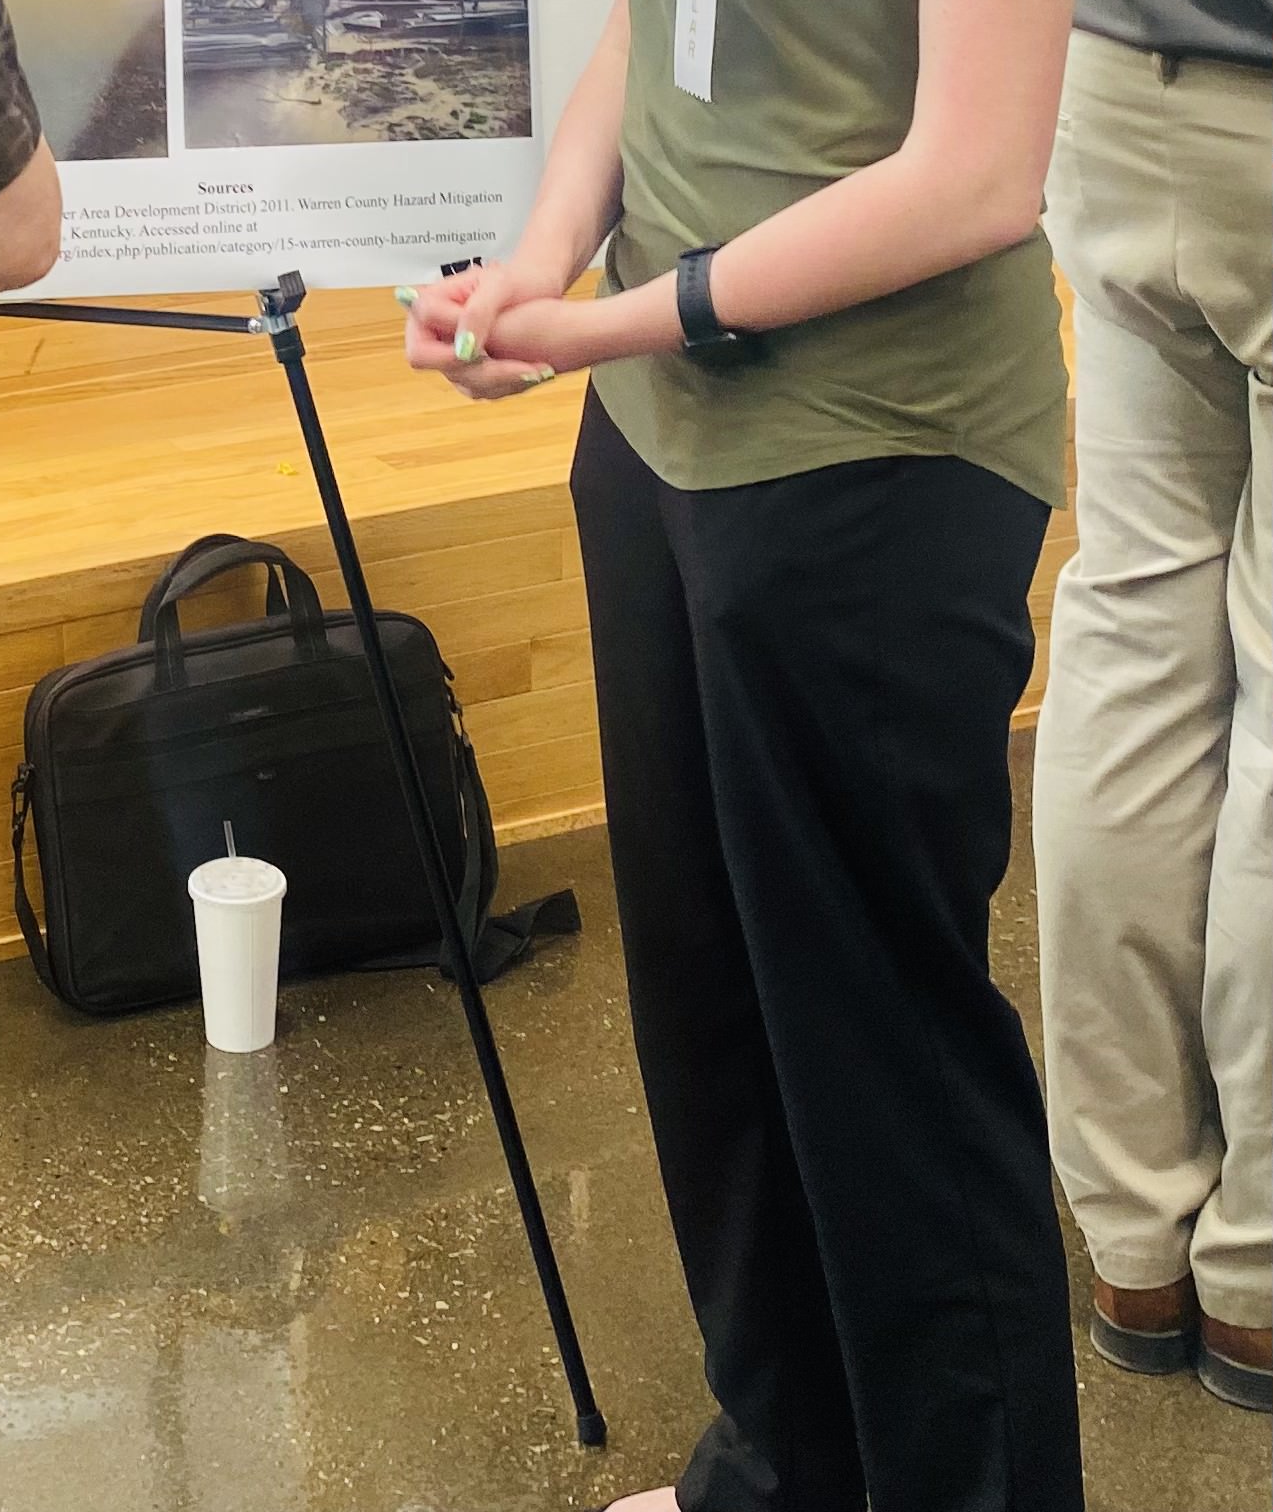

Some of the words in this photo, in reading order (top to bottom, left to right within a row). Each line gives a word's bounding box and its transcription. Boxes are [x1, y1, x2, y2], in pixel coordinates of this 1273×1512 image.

[198, 182, 254, 195] Sources
[80, 208, 111, 220] Area
[114, 204, 200, 220] Development
[204, 201, 256, 215] District)
[260, 198, 295, 213] 2011.
[297, 198, 341, 211] Warren
[345, 195, 389, 210] County
[392, 192, 436, 207] Hazard
[439, 191, 503, 208] Mitigation
[71, 224, 136, 241] Kentucky.
[139, 223, 199, 237] Accessed
[202, 221, 243, 234] online
[246, 222, 258, 233] at
